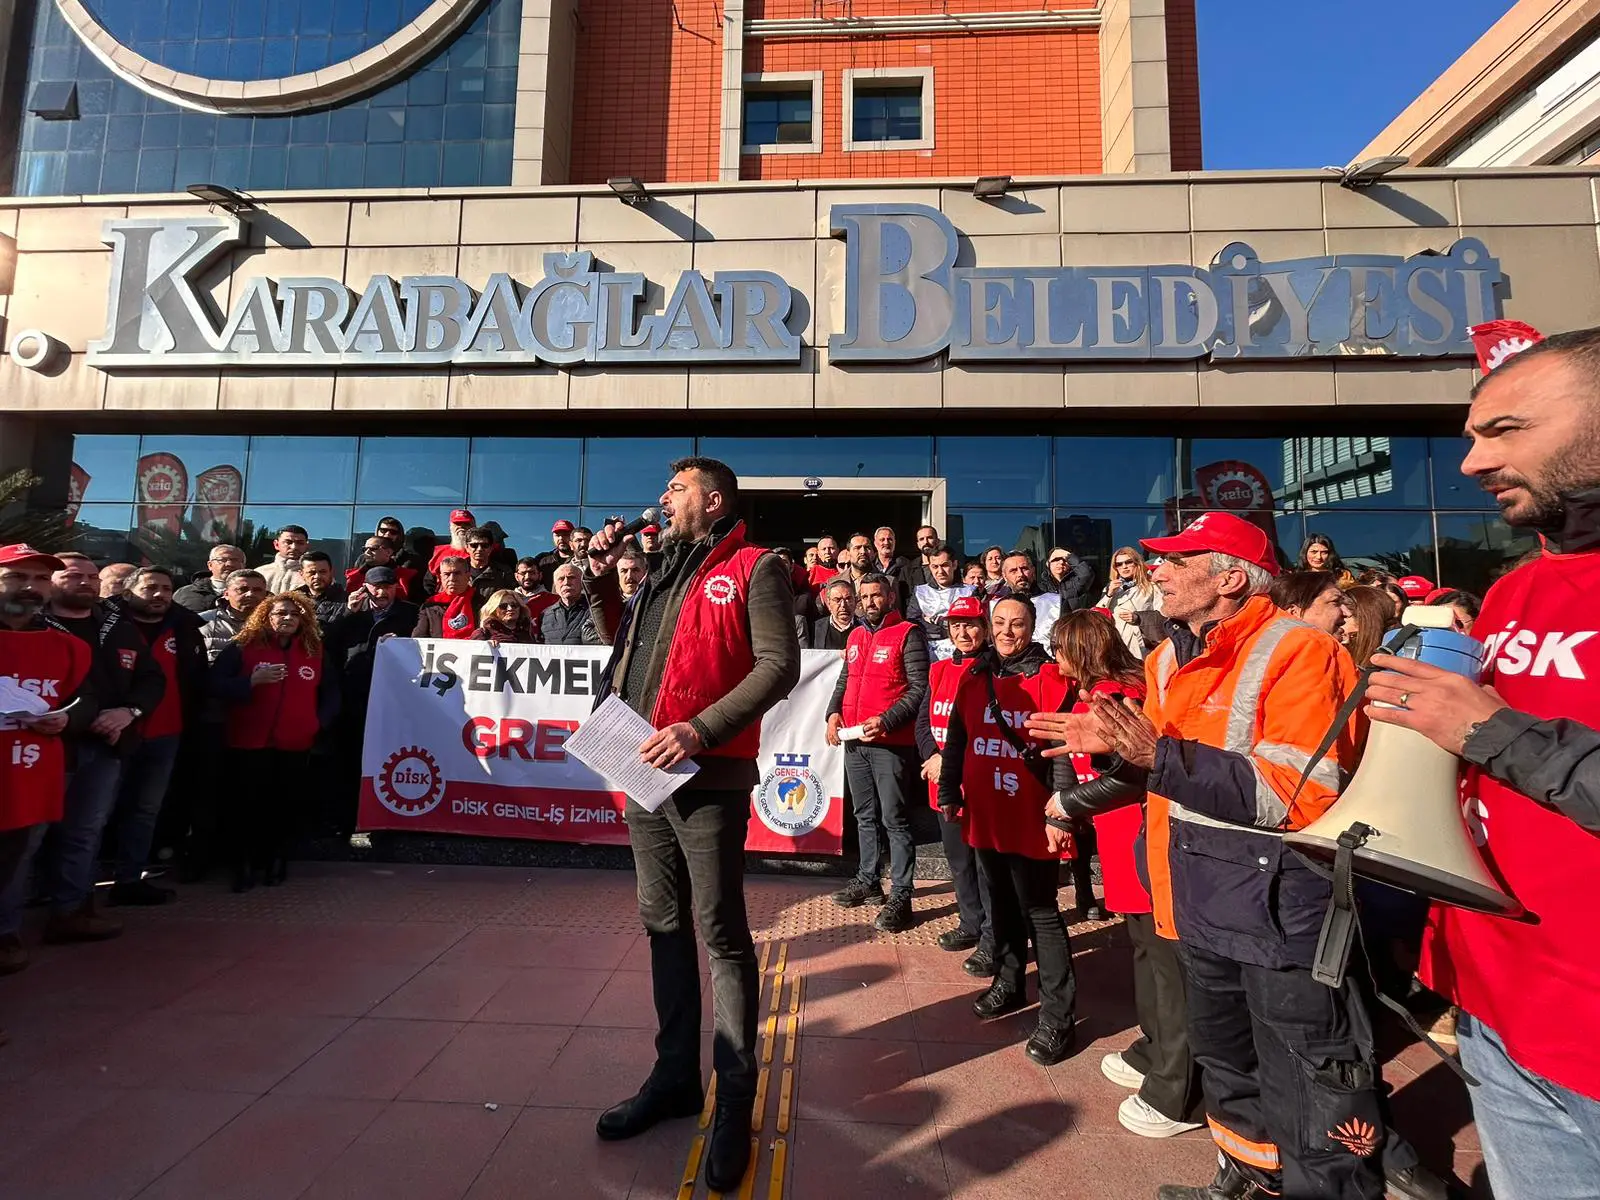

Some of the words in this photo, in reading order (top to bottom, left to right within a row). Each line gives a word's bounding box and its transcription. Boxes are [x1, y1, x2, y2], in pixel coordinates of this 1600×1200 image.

[91, 220, 798, 360] KARABAĞLAR
[832, 207, 1495, 359] BELEDİYESİ
[419, 644, 458, 697] İŞ
[933, 699, 953, 717] DİS
[12, 740, 41, 768] İŞ
[394, 767, 430, 785] DİSK
[994, 767, 1019, 797] İŞ
[452, 797, 488, 816] DİSK
[493, 802, 565, 825] GENEL-İŞ
[570, 804, 617, 824] İZMİR
